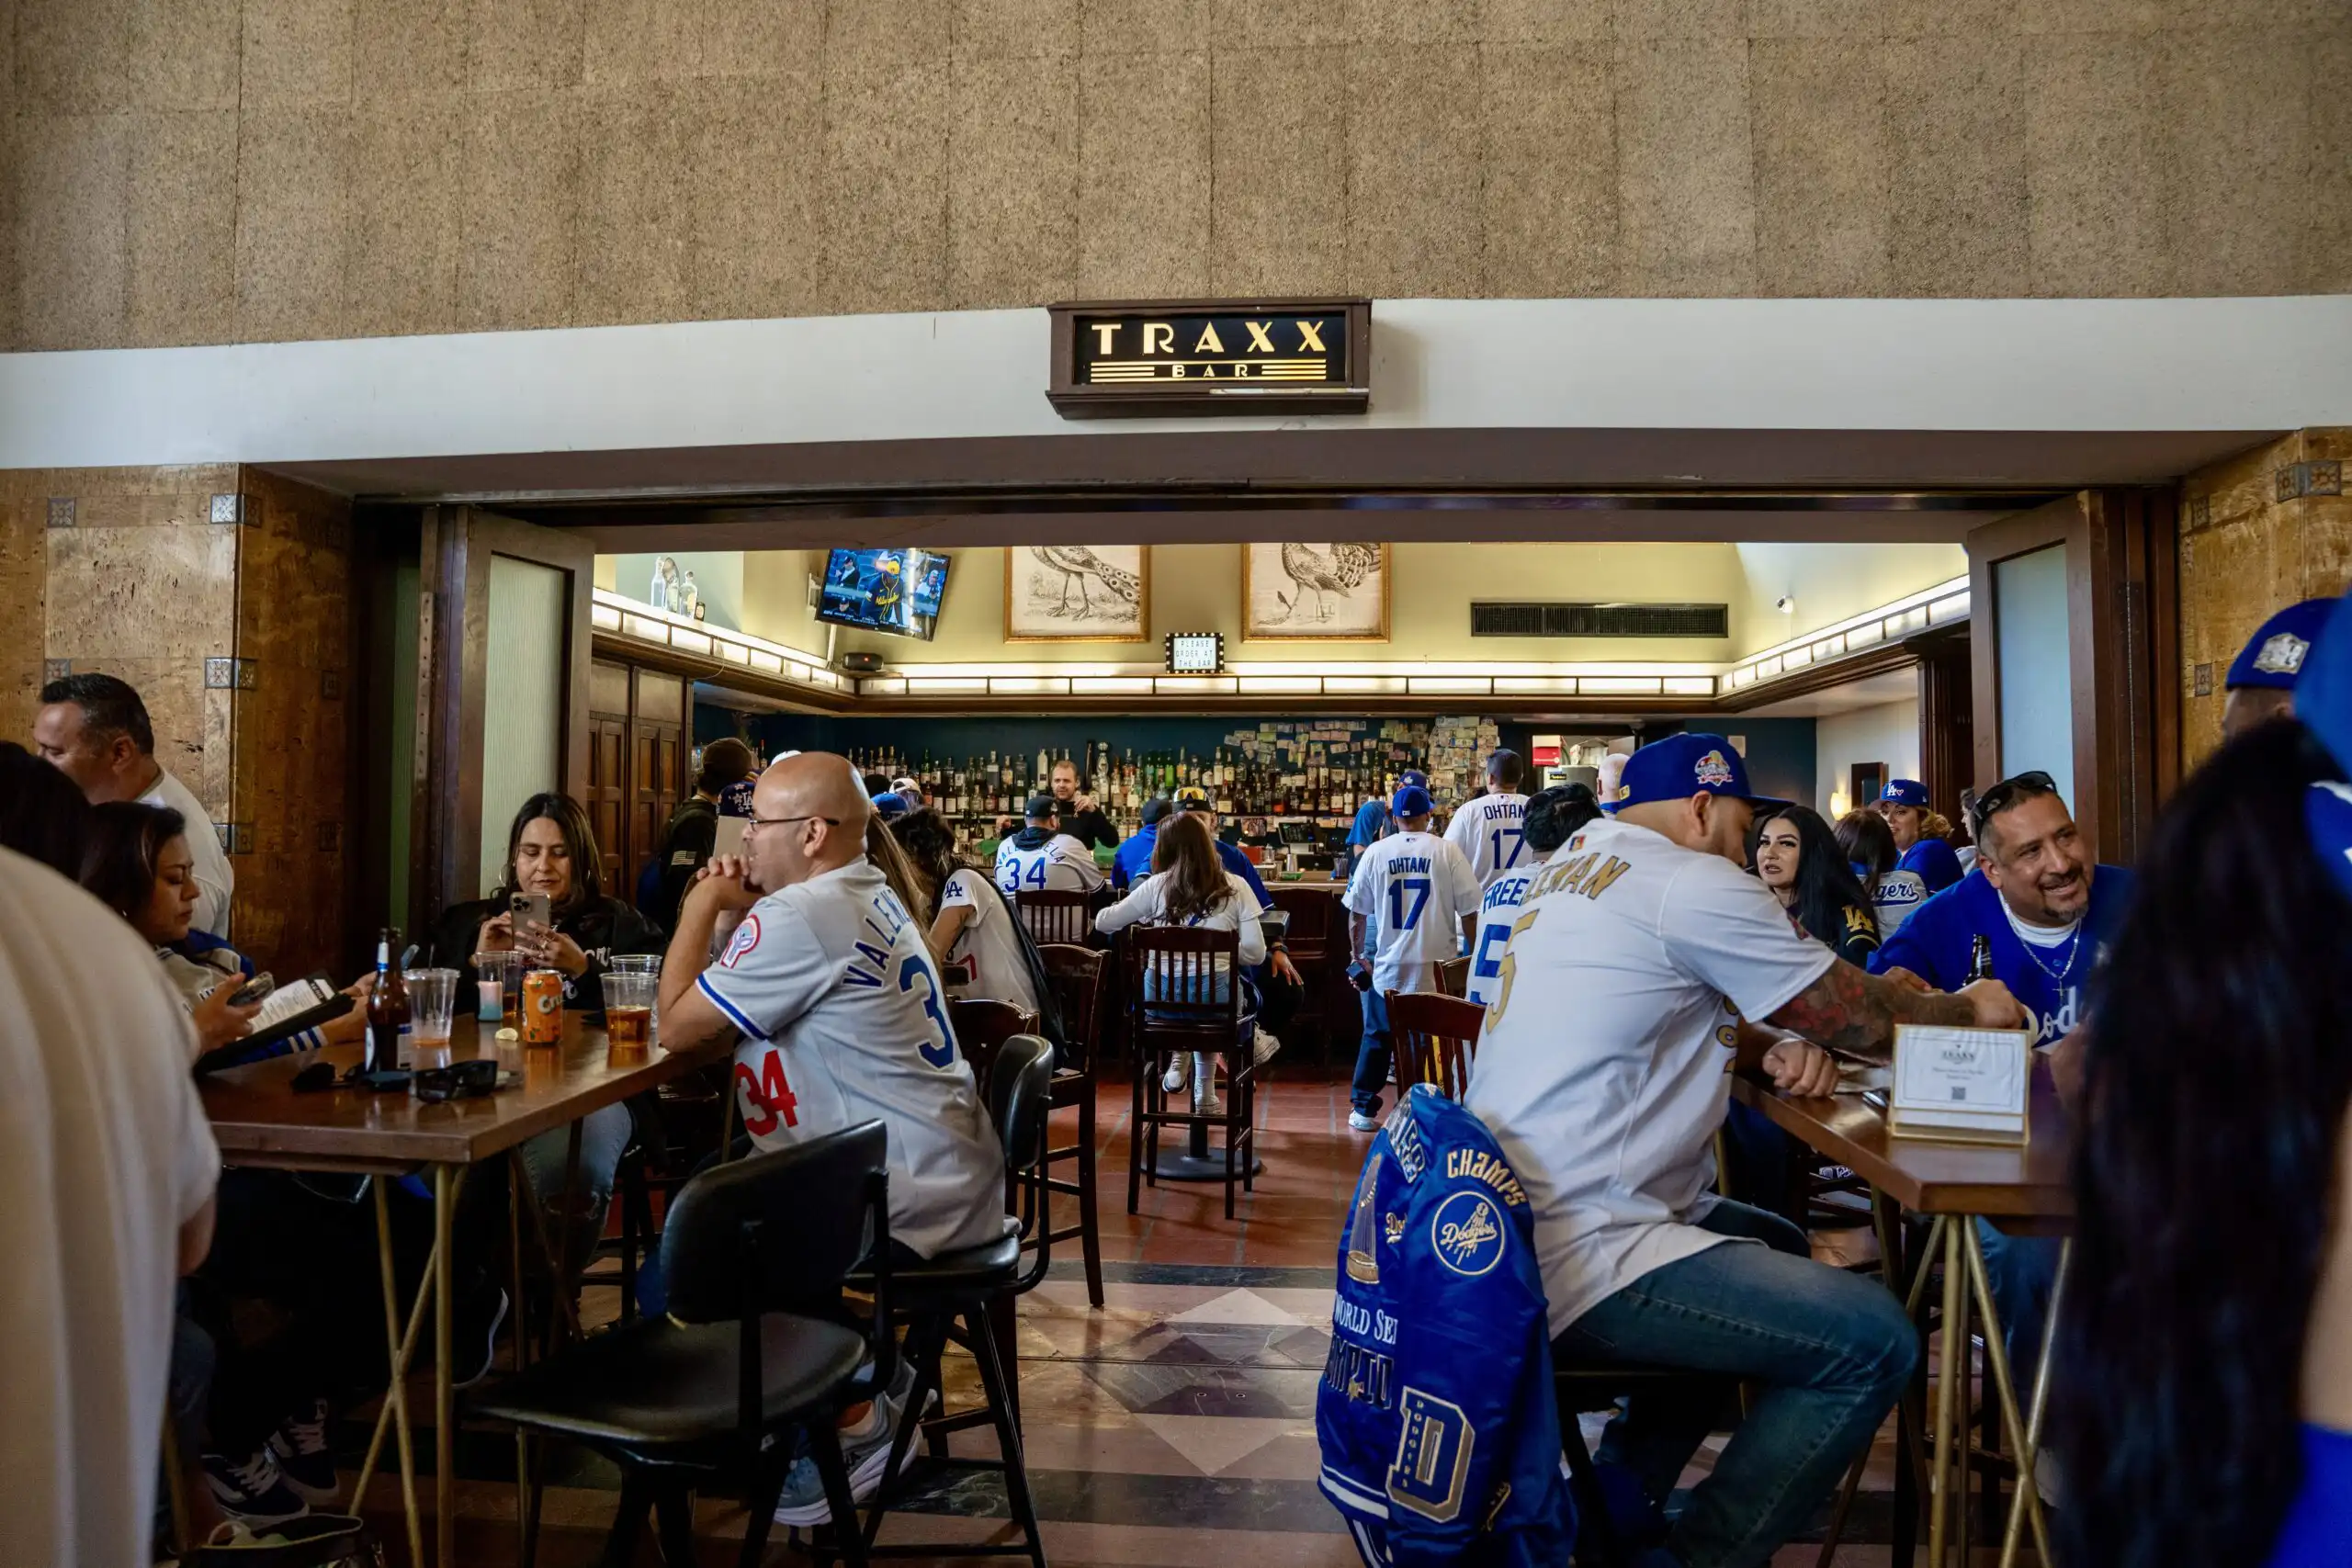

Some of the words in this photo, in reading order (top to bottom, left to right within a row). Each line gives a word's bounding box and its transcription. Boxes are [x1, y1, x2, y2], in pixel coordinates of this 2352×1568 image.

[1091, 321, 1327, 355] TRAXX
[1171, 364, 1249, 378] BAR
[1176, 649, 1198, 658] ORDER
[1204, 649, 1213, 658] AT
[1181, 639, 1209, 648] PLEASE
[1886, 783, 1897, 796] LA
[1490, 829, 1525, 870] 17
[1004, 856, 1047, 892] 34
[1388, 857, 1431, 875] OHTANI
[945, 880, 963, 898] LA
[1388, 879, 1430, 931] 17
[1842, 904, 1875, 933] LA
[1486, 908, 1541, 1035] 5
[734, 1049, 798, 1137] 34
[1440, 1221, 1498, 1250] Dodgers
[1334, 1292, 1371, 1336] WORLD
[1385, 1385, 1476, 1524] D
